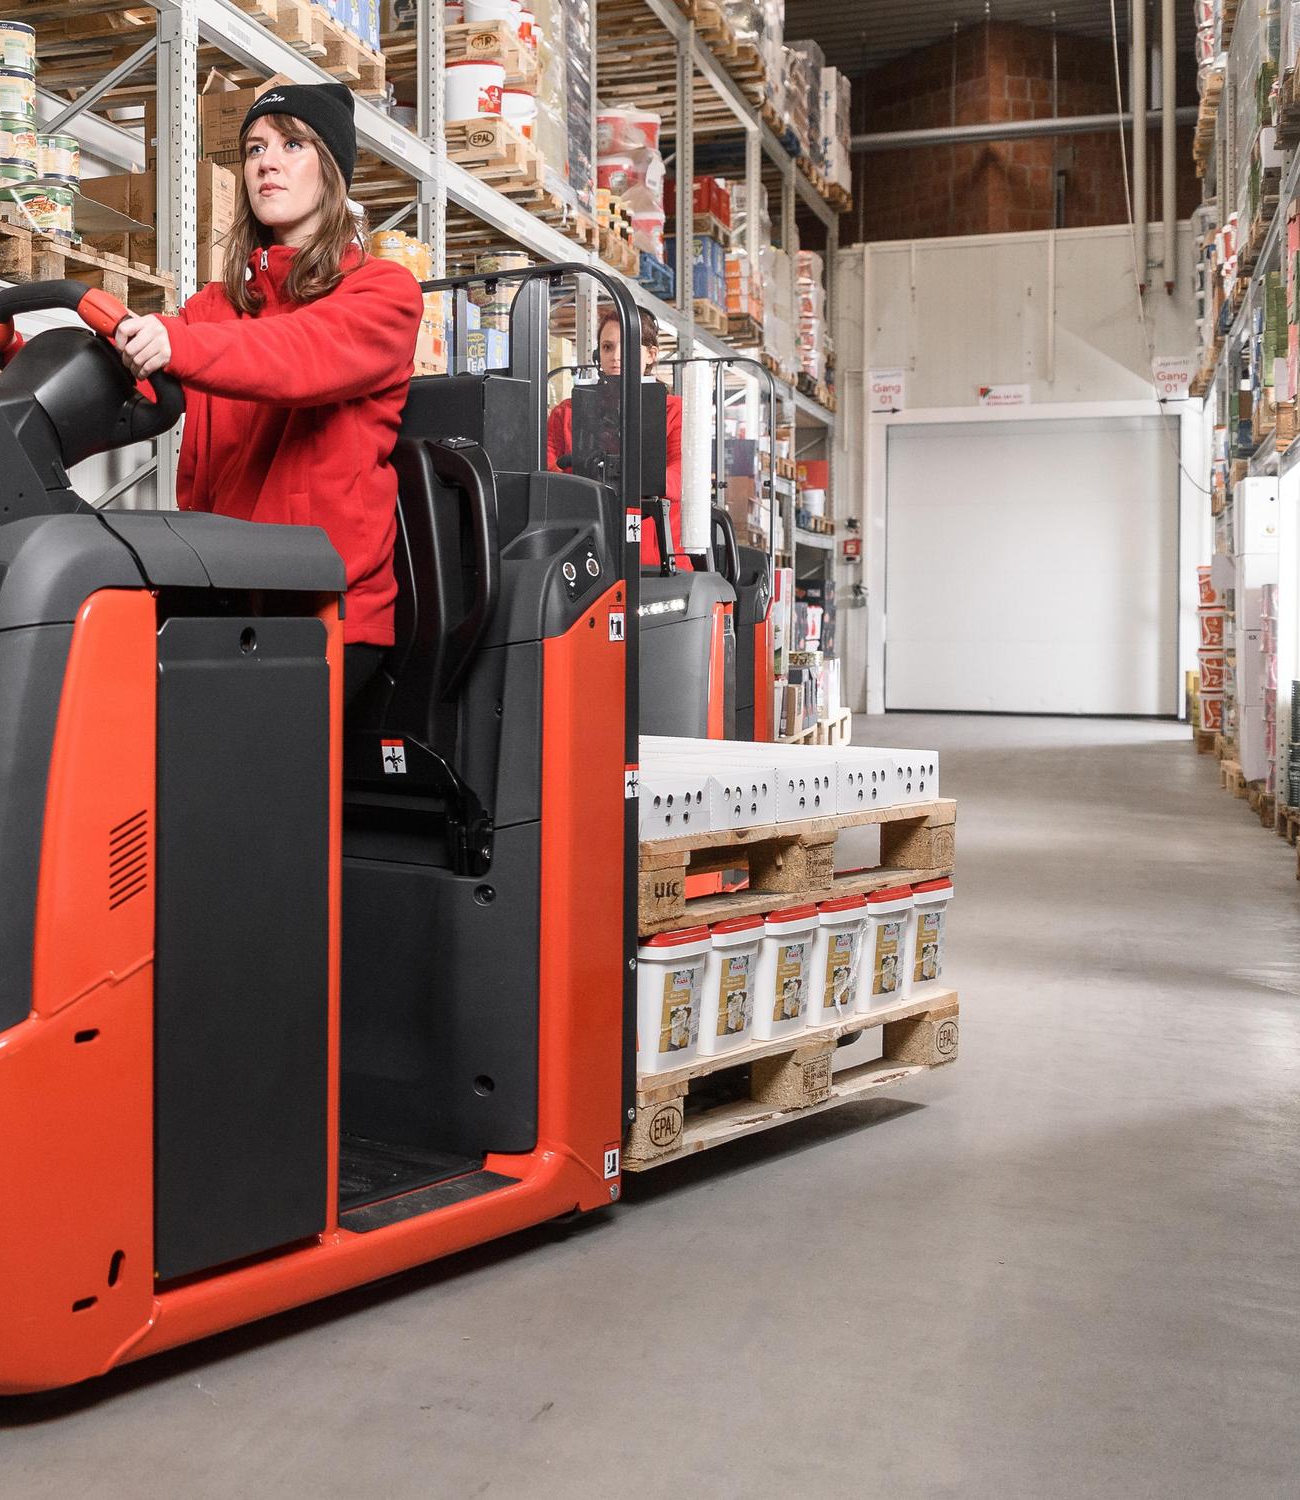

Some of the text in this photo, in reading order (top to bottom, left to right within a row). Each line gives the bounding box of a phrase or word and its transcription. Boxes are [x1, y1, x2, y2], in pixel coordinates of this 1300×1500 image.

[472, 134, 490, 143] EPAL
[1157, 371, 1188, 382] Gang
[873, 384, 901, 394] Gang
[1165, 383, 1178, 392] 01
[880, 395, 892, 404] 01
[654, 1113, 677, 1140] EPAL
